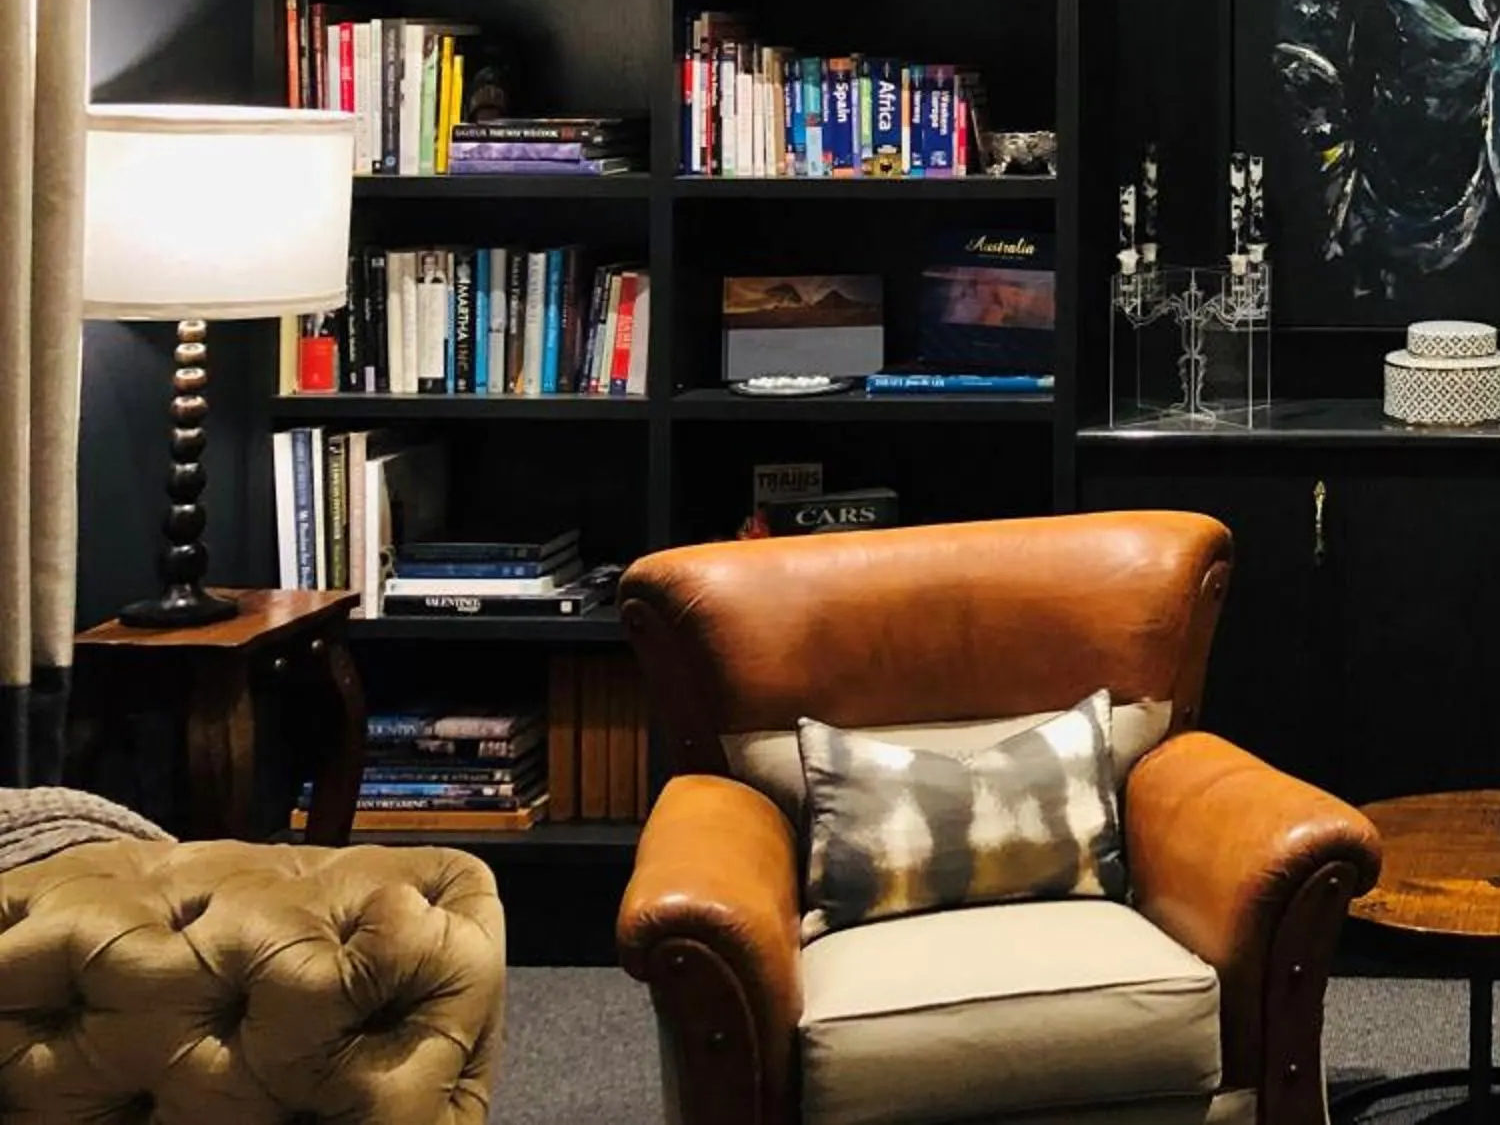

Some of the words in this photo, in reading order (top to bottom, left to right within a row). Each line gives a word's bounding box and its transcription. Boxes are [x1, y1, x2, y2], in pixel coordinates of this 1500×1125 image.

[835, 82, 851, 123] Spain
[877, 80, 895, 131] Africa
[965, 235, 1036, 256] Australia
[456, 283, 471, 342] MARTHA
[795, 506, 876, 525] CARS
